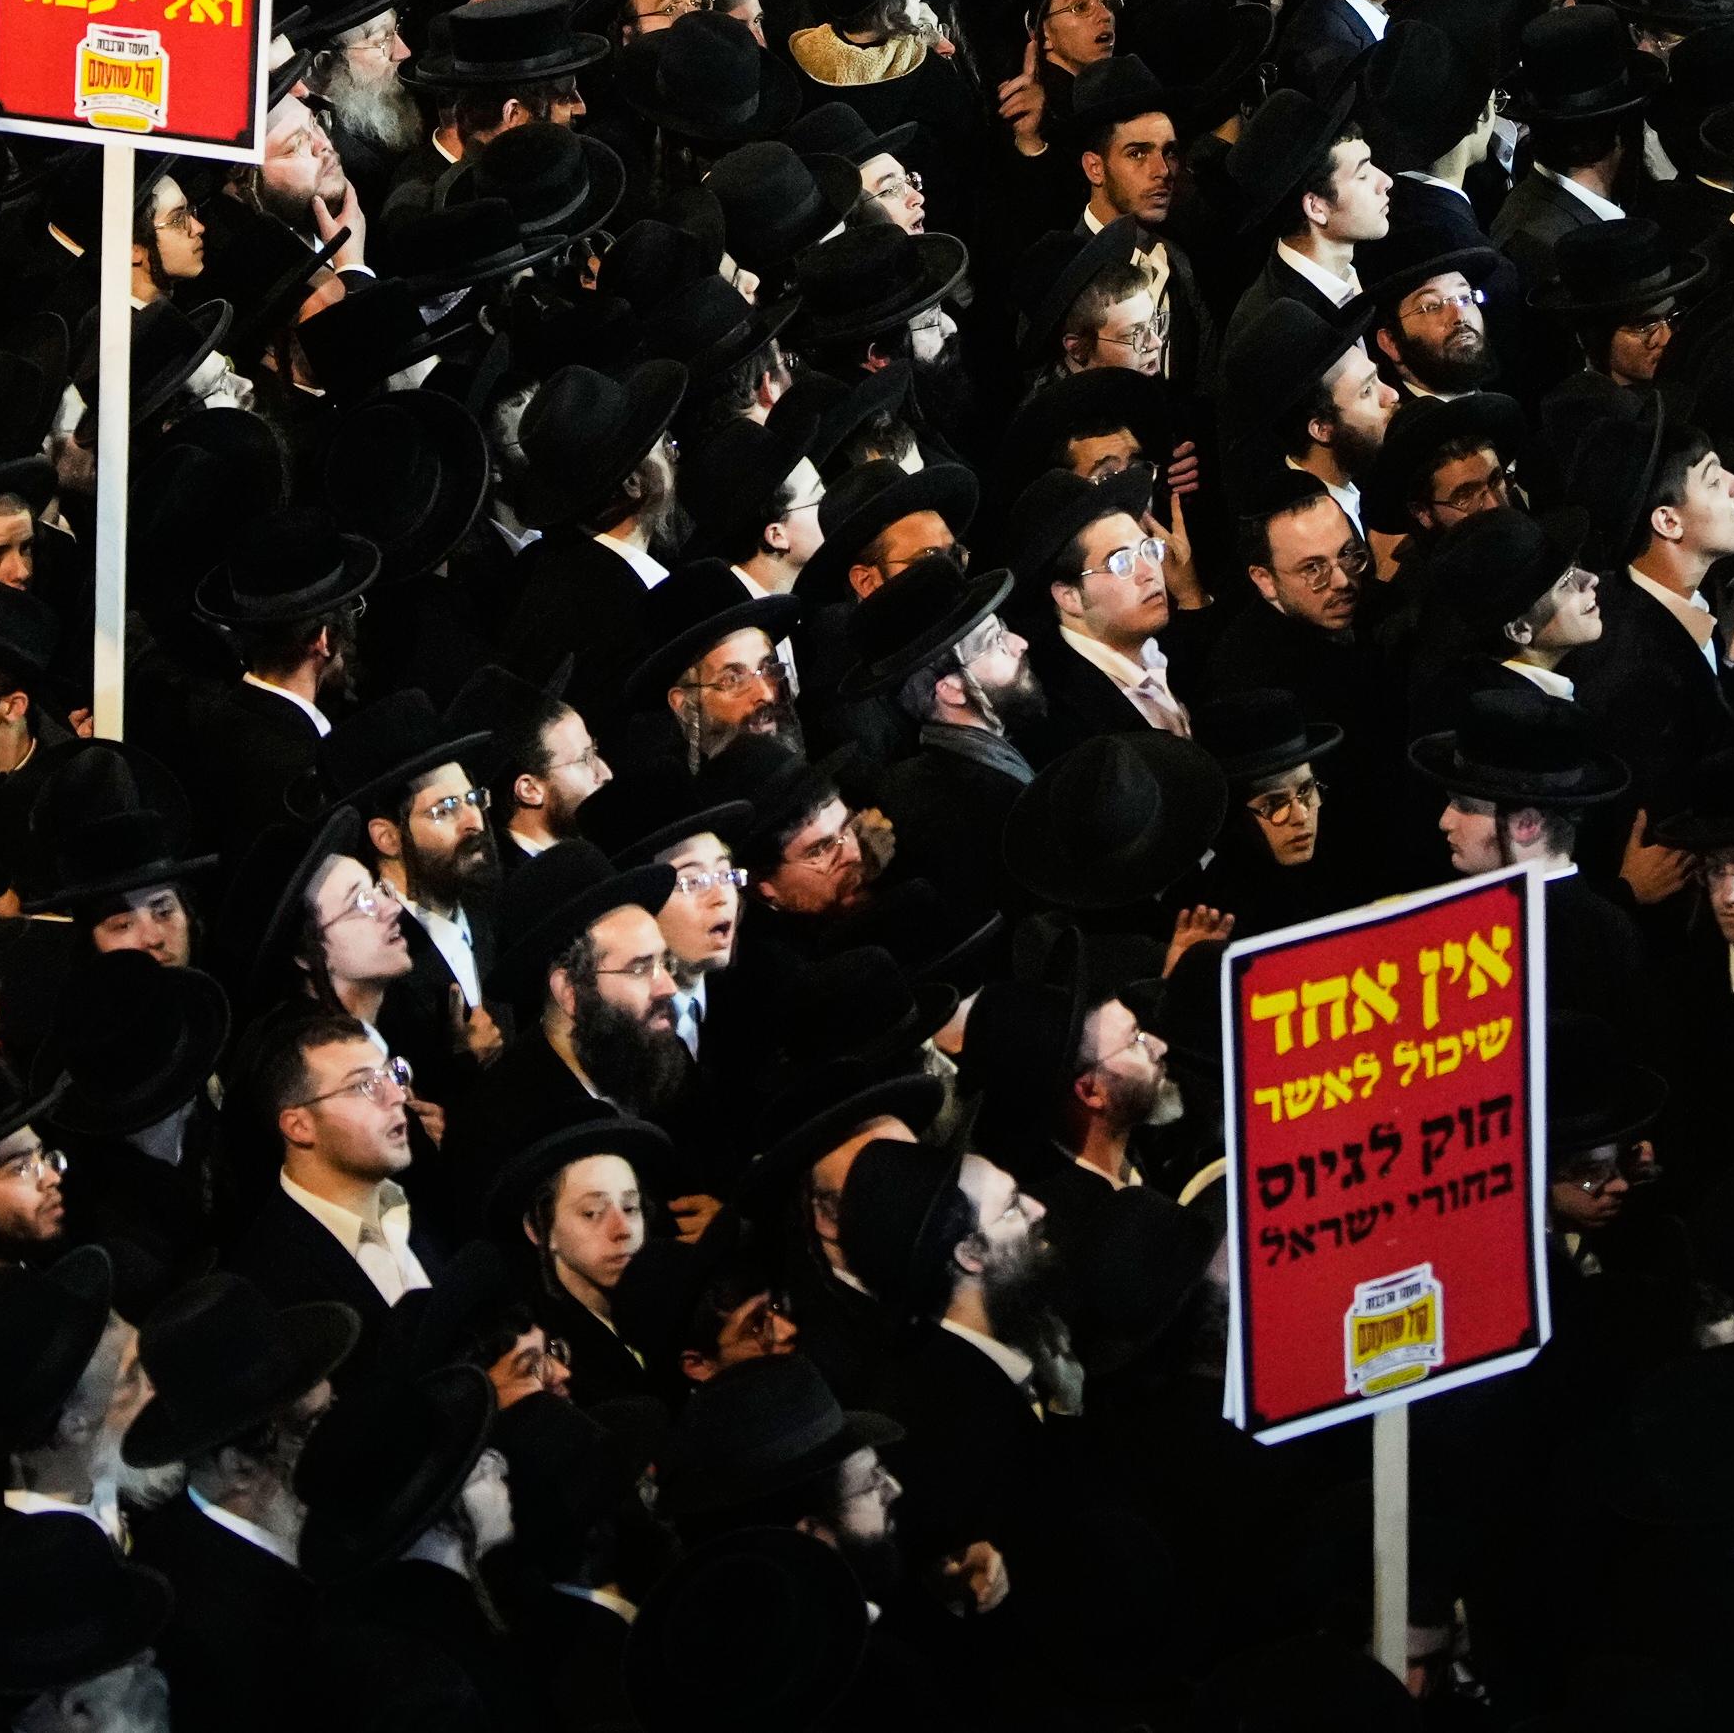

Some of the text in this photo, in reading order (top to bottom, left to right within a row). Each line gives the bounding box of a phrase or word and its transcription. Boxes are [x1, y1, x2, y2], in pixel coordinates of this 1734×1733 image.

[89, 59, 154, 97] קול שוועתם
[1250, 924, 1513, 1056] אין אחד
[1252, 1015, 1513, 1123] שיכול לאשר
[1256, 1093, 1513, 1210] חוק לגיוס
[1260, 1162, 1515, 1267] בחורי ישראל
[1407, 1303, 1428, 1341] קול
